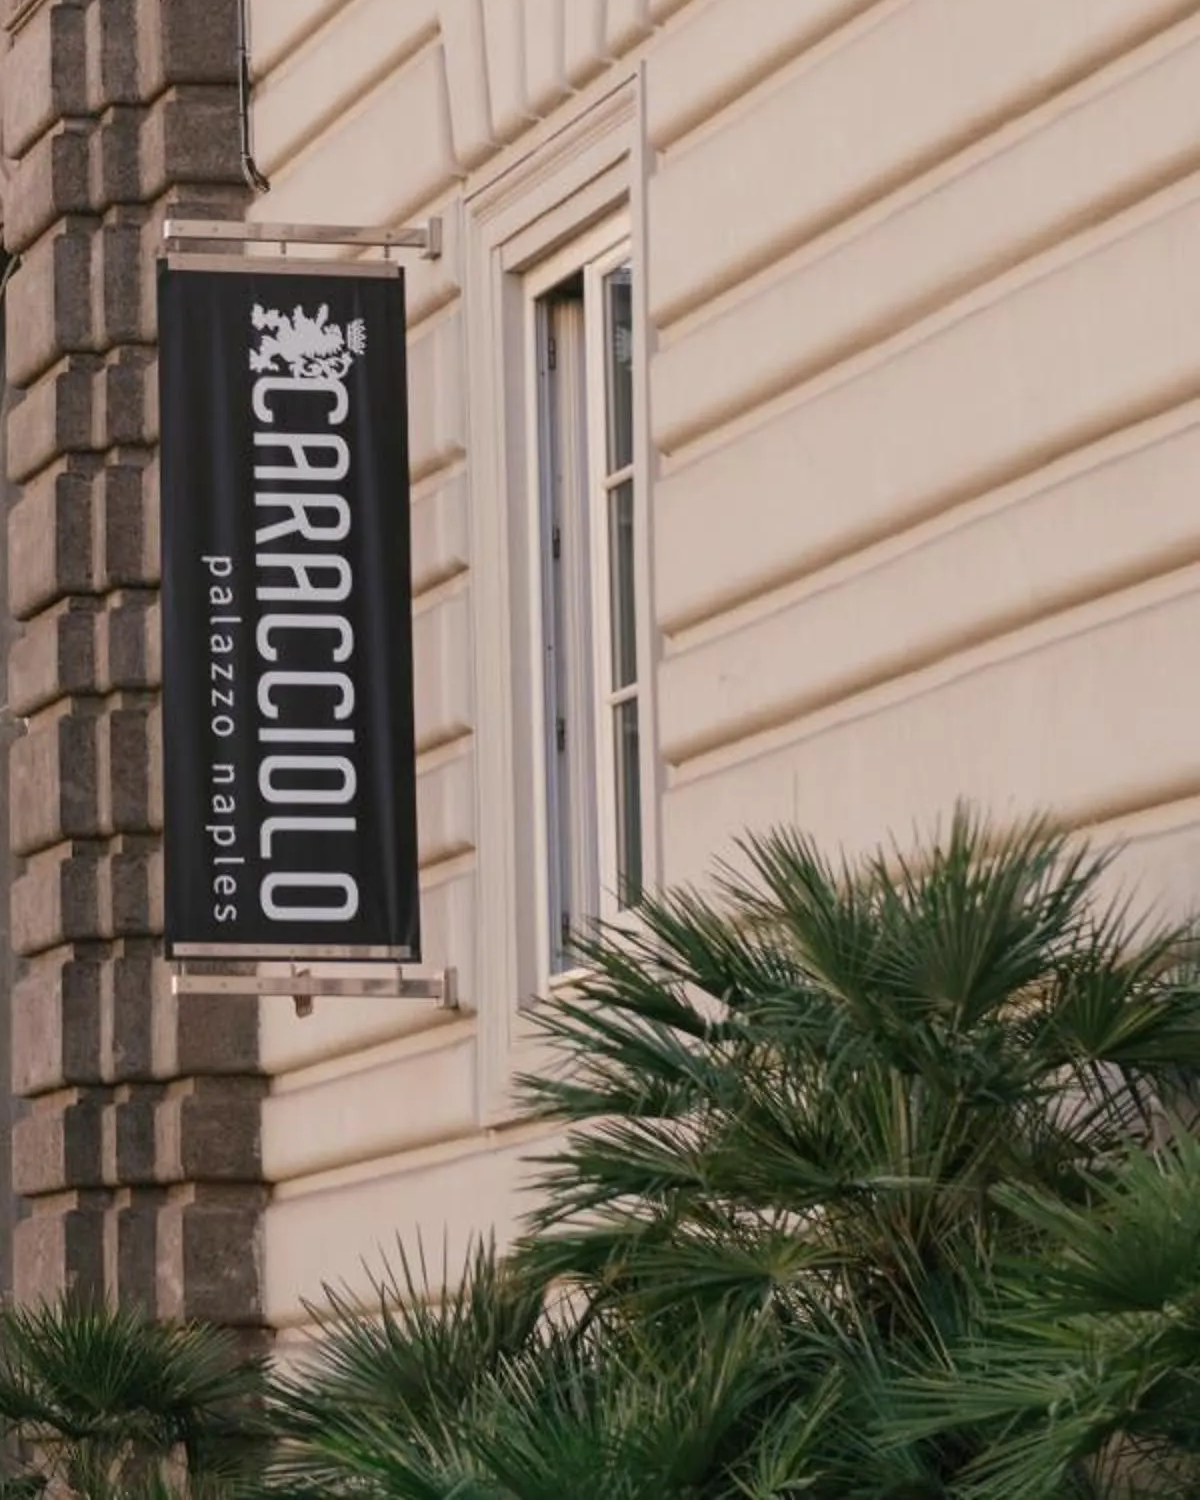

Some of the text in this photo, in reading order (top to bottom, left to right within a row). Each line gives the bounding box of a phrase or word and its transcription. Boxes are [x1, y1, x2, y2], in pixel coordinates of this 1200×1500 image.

[201, 556, 245, 922] palazzo naples
[251, 375, 359, 921] CARACCIOLO
